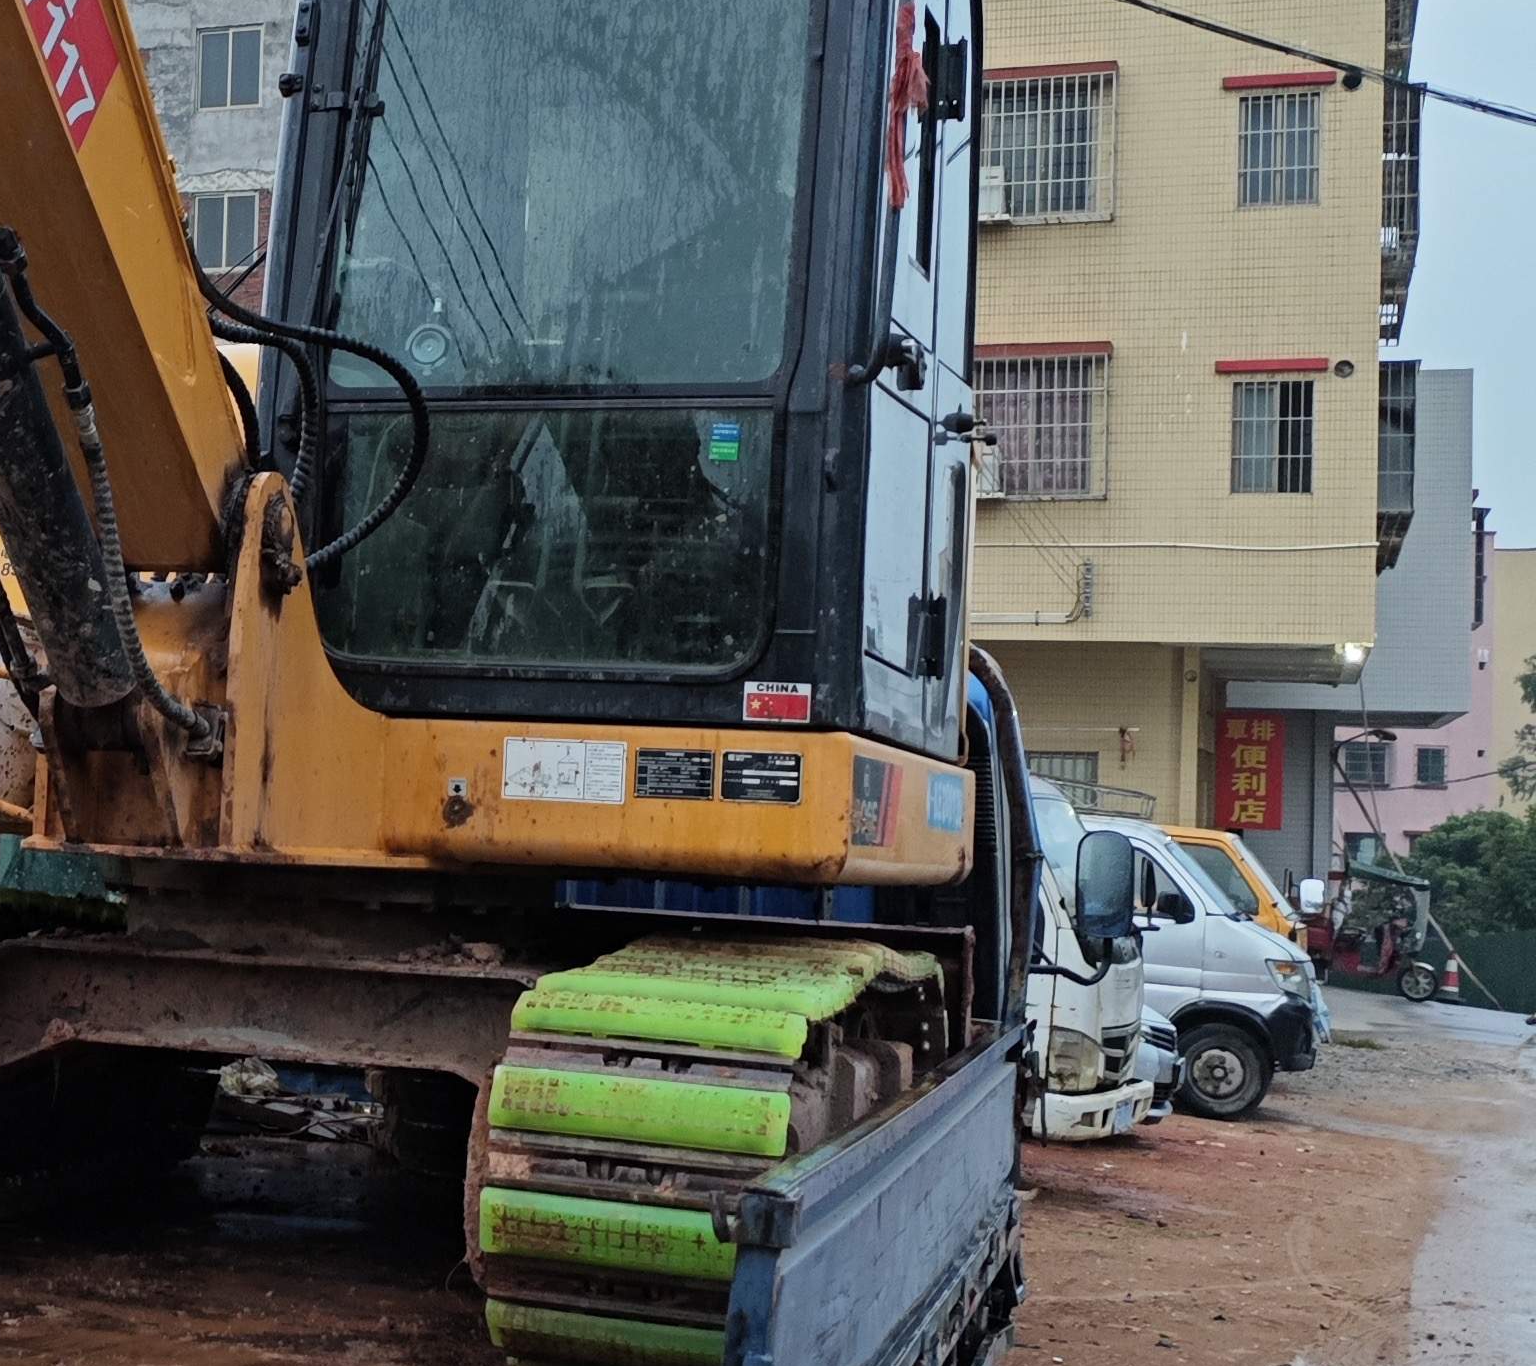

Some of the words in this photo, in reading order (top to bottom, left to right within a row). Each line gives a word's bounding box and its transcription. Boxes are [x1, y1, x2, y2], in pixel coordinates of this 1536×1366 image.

[756, 682, 799, 694] CHINA
[1230, 744, 1268, 825] 便利店
